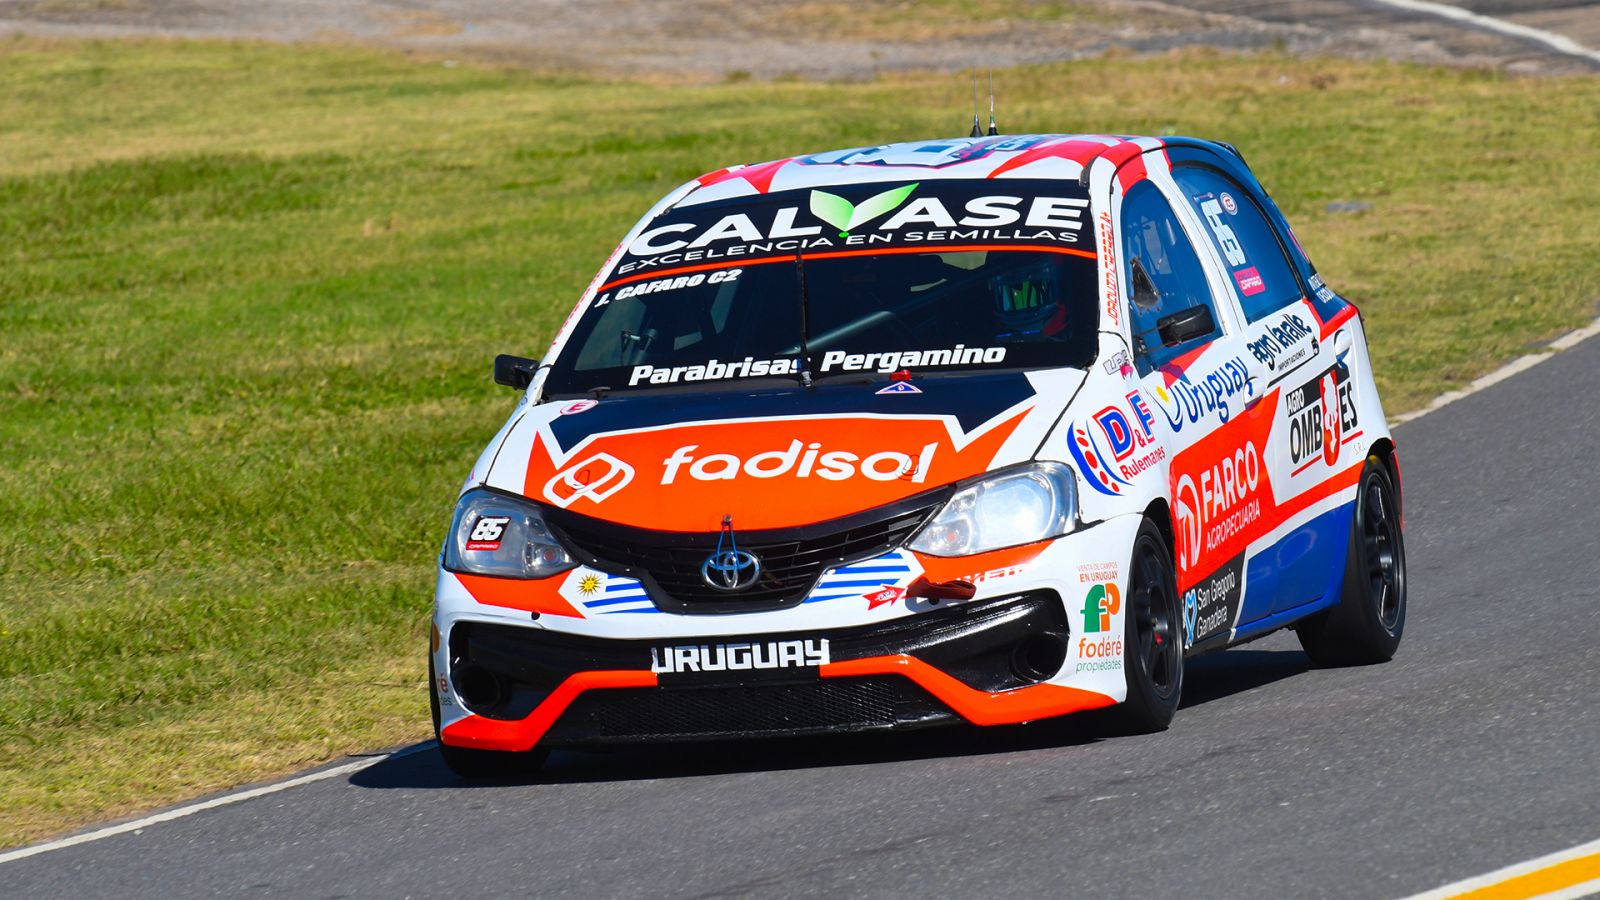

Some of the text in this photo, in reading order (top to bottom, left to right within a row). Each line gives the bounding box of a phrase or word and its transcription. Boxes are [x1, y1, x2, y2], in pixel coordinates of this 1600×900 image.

[1200, 198, 1247, 267] 85
[618, 228, 1079, 275] EXCELENCIA EN SEMILLAS
[615, 272, 705, 301] CAFARO
[709, 268, 743, 286] C2
[628, 343, 1007, 387] Parabrisas Pergamino
[1246, 333, 1282, 371] agro
[1278, 347, 1306, 372] IMPORTACIONES
[1174, 356, 1253, 424] Uruguay
[1287, 388, 1305, 415] AGRO
[659, 438, 939, 485] fadisol
[1119, 445, 1166, 481] Rulemanes
[1201, 440, 1259, 523] FARCO
[470, 518, 510, 540] 85
[1206, 498, 1260, 555] AGROPECUARIA
[1078, 563, 1093, 572] VENTA
[1093, 562, 1100, 571] DE
[1080, 571, 1119, 583] EN URUGUAY
[1197, 568, 1236, 611] San Gregorio
[1196, 604, 1228, 639] Ganadera
[651, 638, 831, 674] URUGUAY
[1078, 635, 1122, 658] fodéré
[1076, 660, 1122, 674] propiedades
